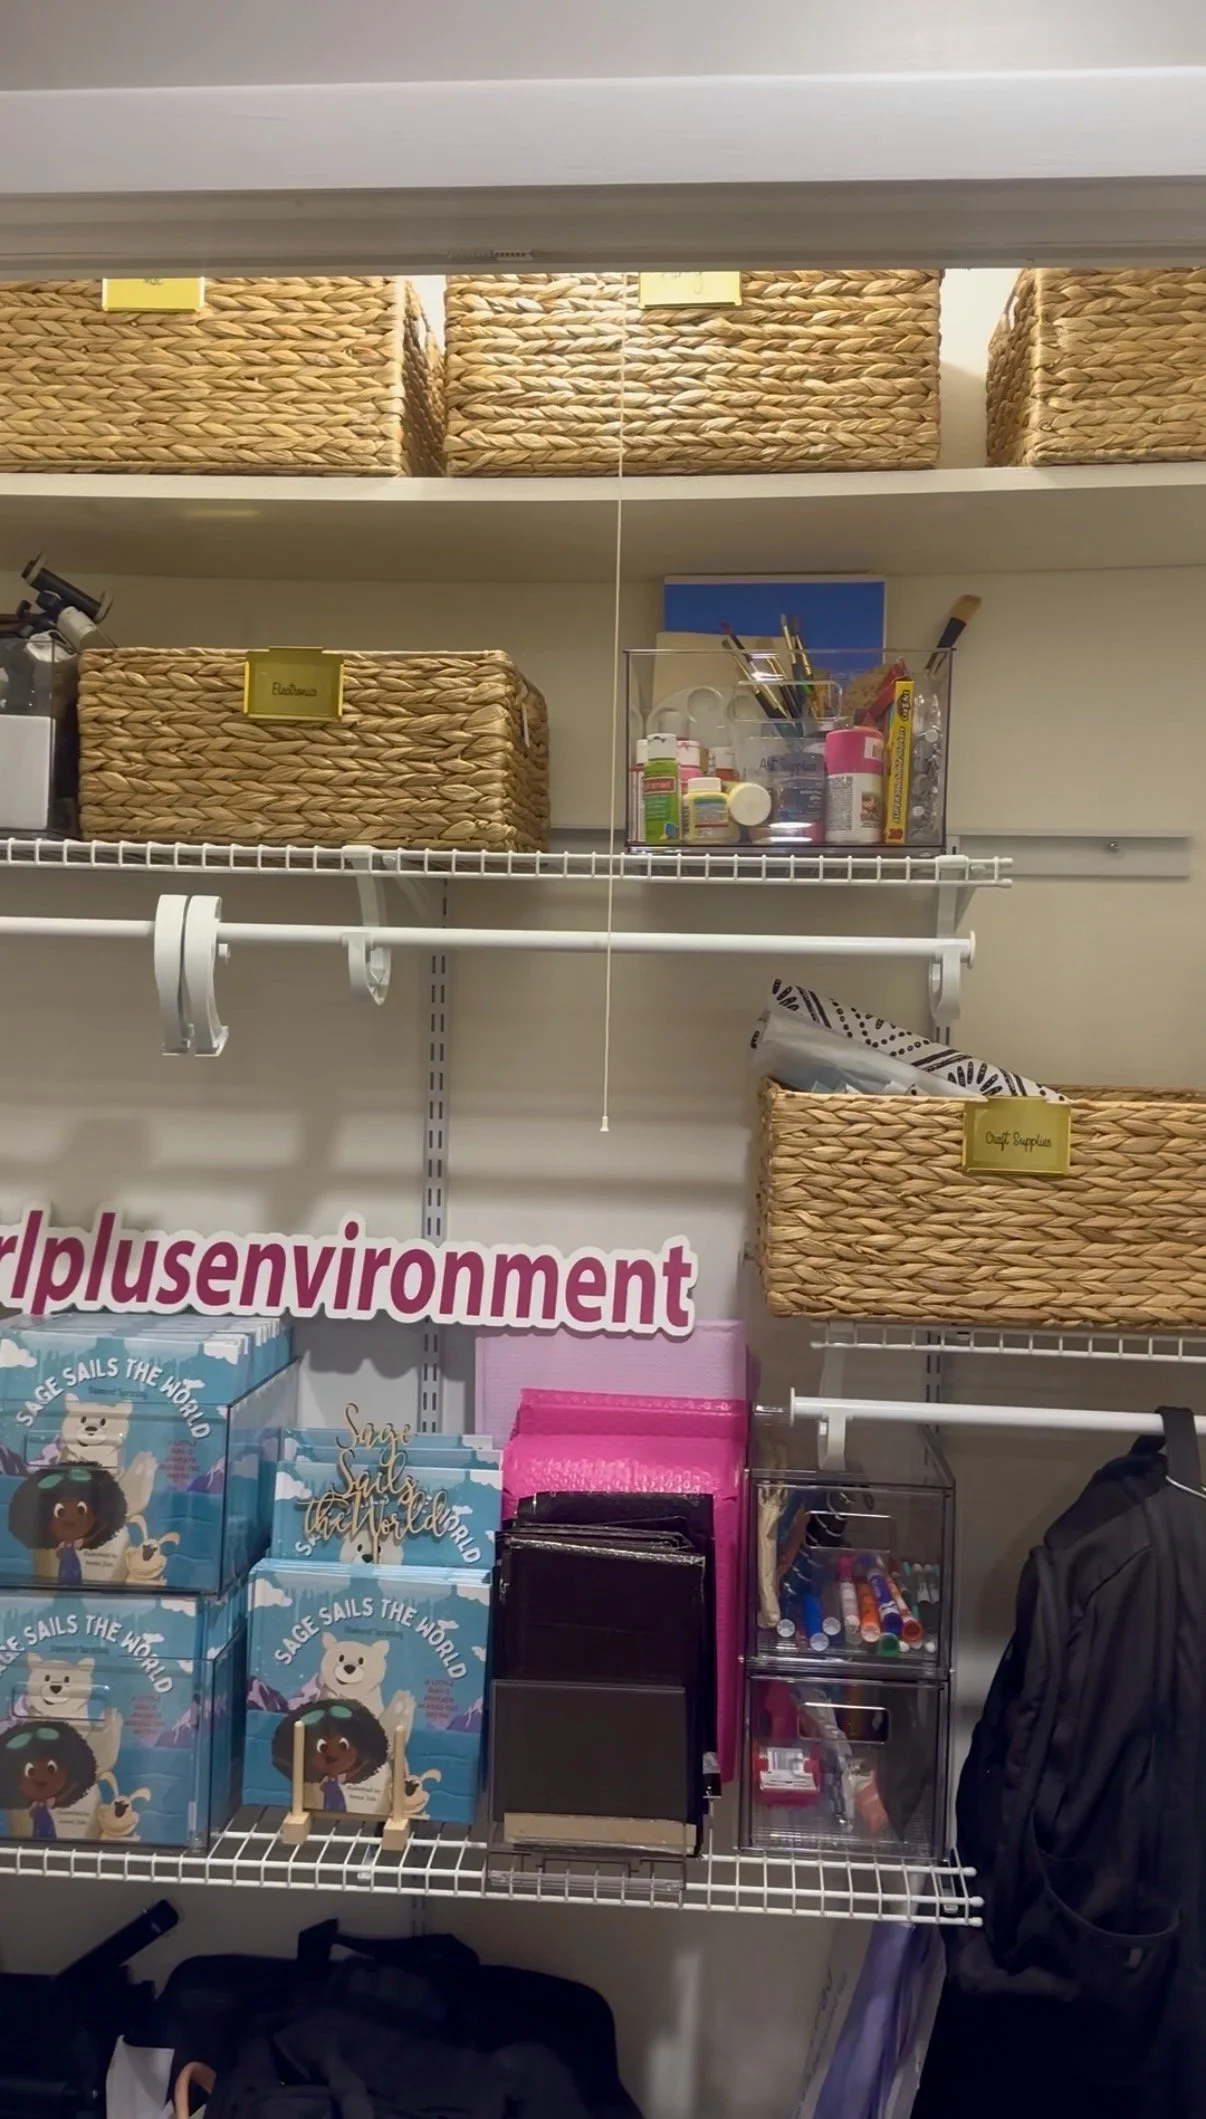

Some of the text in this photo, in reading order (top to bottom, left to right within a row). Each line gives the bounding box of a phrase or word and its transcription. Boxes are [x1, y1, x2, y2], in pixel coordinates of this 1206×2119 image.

[985, 1130, 1052, 1153] Craft Supplies
[16, 1357, 212, 1440] SAGE SAILS THE WORLD
[336, 1402, 412, 1467] Sage
[332, 1449, 417, 1506] Sails
[348, 1489, 451, 1540] World
[24, 1614, 78, 1645] SAILS
[86, 1614, 122, 1643] THE
[120, 1631, 173, 1694] WORLD
[275, 1597, 468, 1680] SAGE SAILS THE WORLD
